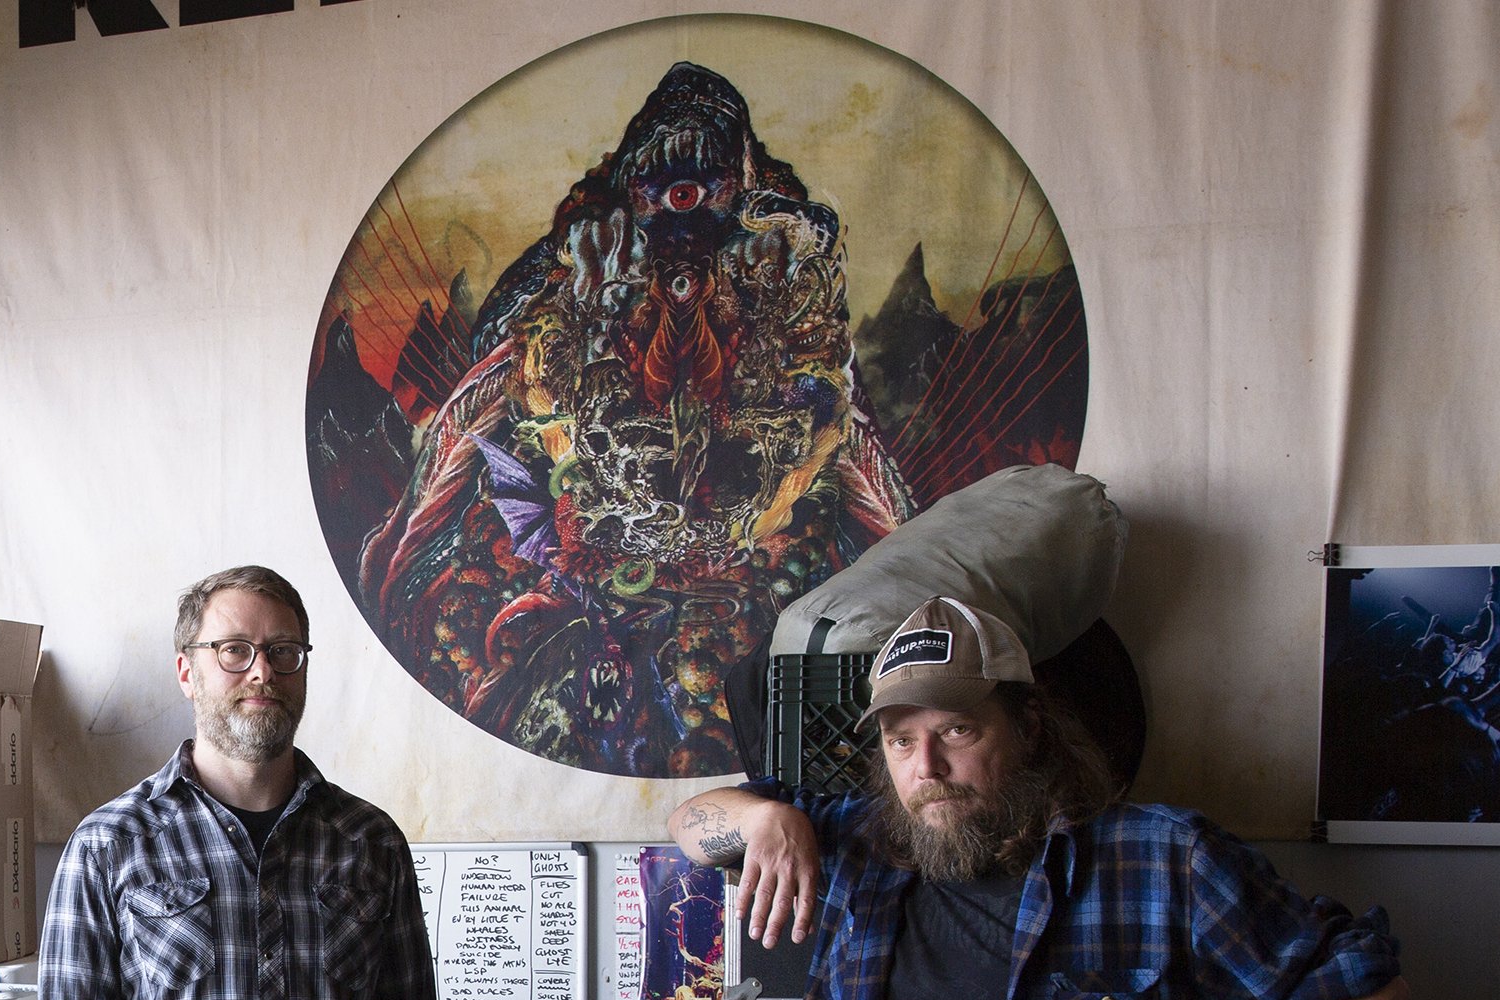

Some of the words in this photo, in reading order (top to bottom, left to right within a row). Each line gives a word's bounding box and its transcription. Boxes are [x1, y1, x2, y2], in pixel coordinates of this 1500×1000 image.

[918, 639, 947, 648] MUSIC
[533, 852, 561, 862] ONLY
[534, 862, 569, 873] GHOSTS
[461, 872, 512, 881] UNDERTOW
[461, 883, 496, 892] HUMAN
[498, 883, 527, 892] HERD
[540, 881, 571, 889] FLIES
[461, 892, 508, 902] FAILURE
[541, 891, 563, 900] CUT
[461, 904, 481, 913] THIS
[483, 904, 527, 913] ANIMAL
[540, 901, 553, 909] NO
[555, 901, 577, 910] AIR
[481, 914, 509, 924] LITTLE
[540, 920, 558, 928] NOT
[466, 926, 509, 934] WHALES
[544, 928, 575, 937] SMELL
[465, 935, 516, 944] WITNESS
[456, 942, 487, 951] DAWN
[460, 951, 502, 959] SUICIDE
[535, 947, 573, 957] GHOST
[443, 958, 477, 966] MURDER
[546, 956, 572, 967] LYE
[464, 967, 488, 976] LSP
[463, 976, 498, 985] ALWAYS
[450, 988, 473, 996] BAD
[476, 987, 514, 996] PLACES
